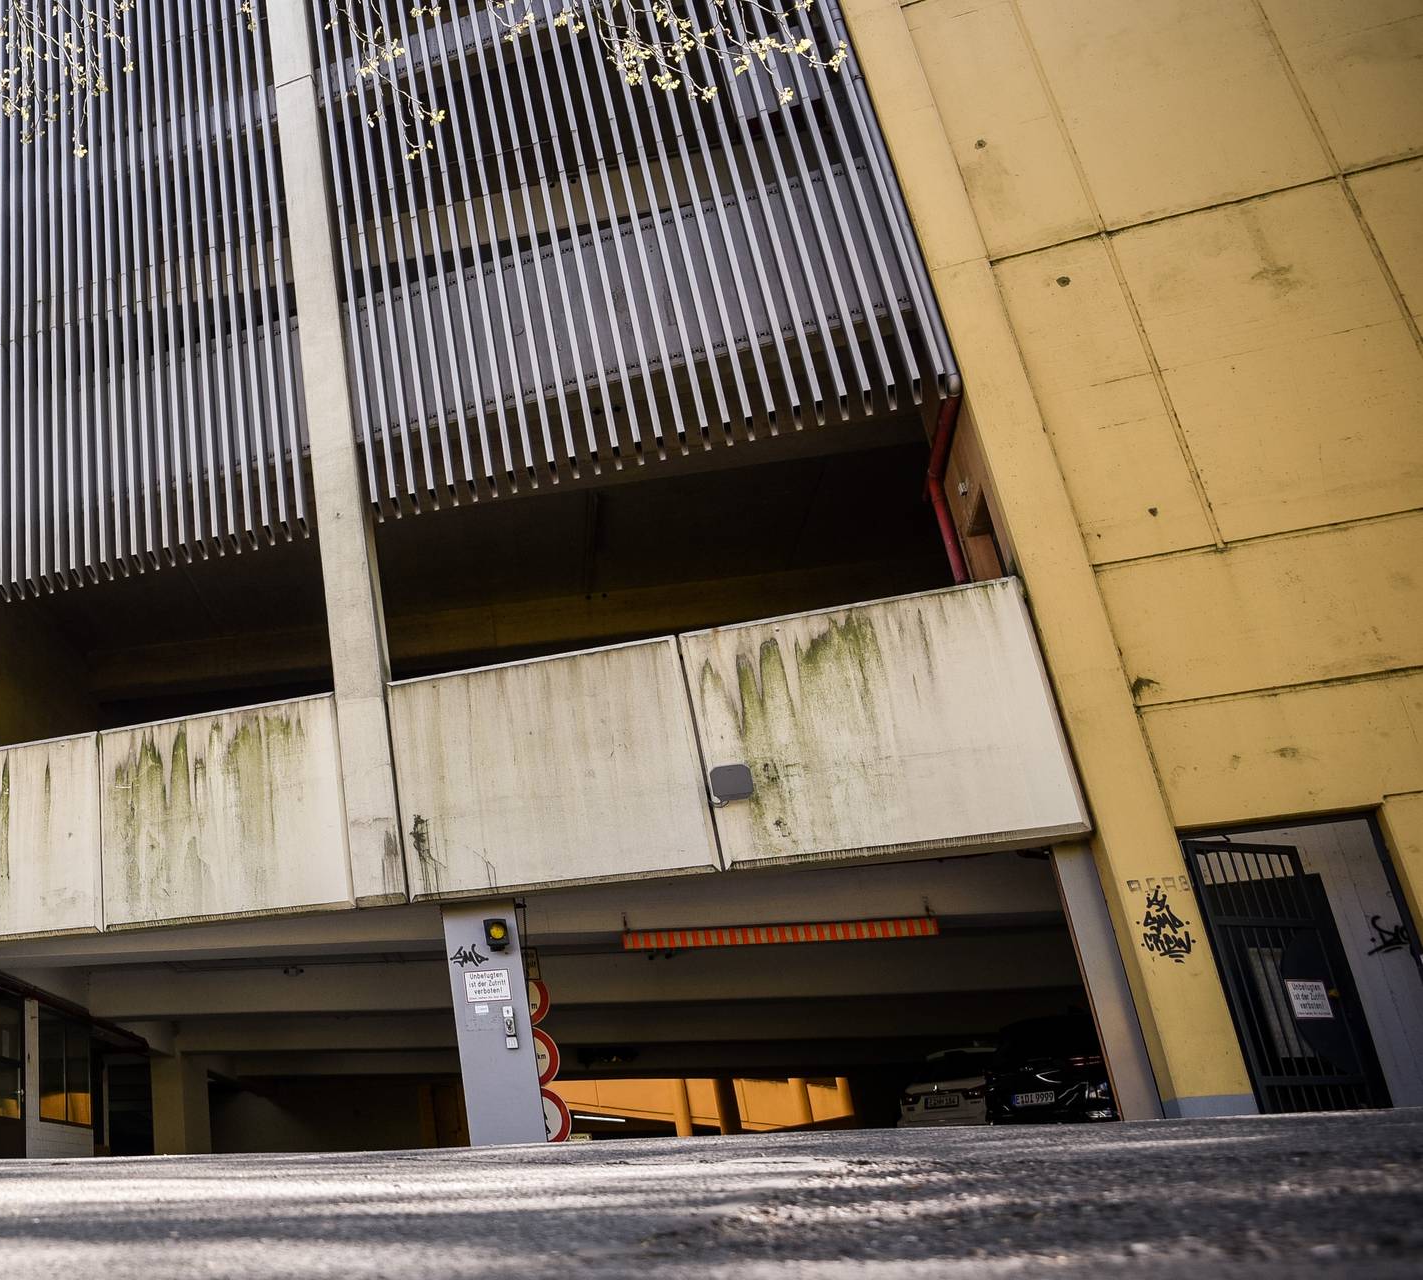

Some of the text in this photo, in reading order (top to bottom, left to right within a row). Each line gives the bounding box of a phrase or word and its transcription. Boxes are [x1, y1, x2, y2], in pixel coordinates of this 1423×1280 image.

[469, 971, 504, 980] Unbefugten
[488, 979, 507, 987] Zutritt
[473, 986, 503, 995] verboten!
